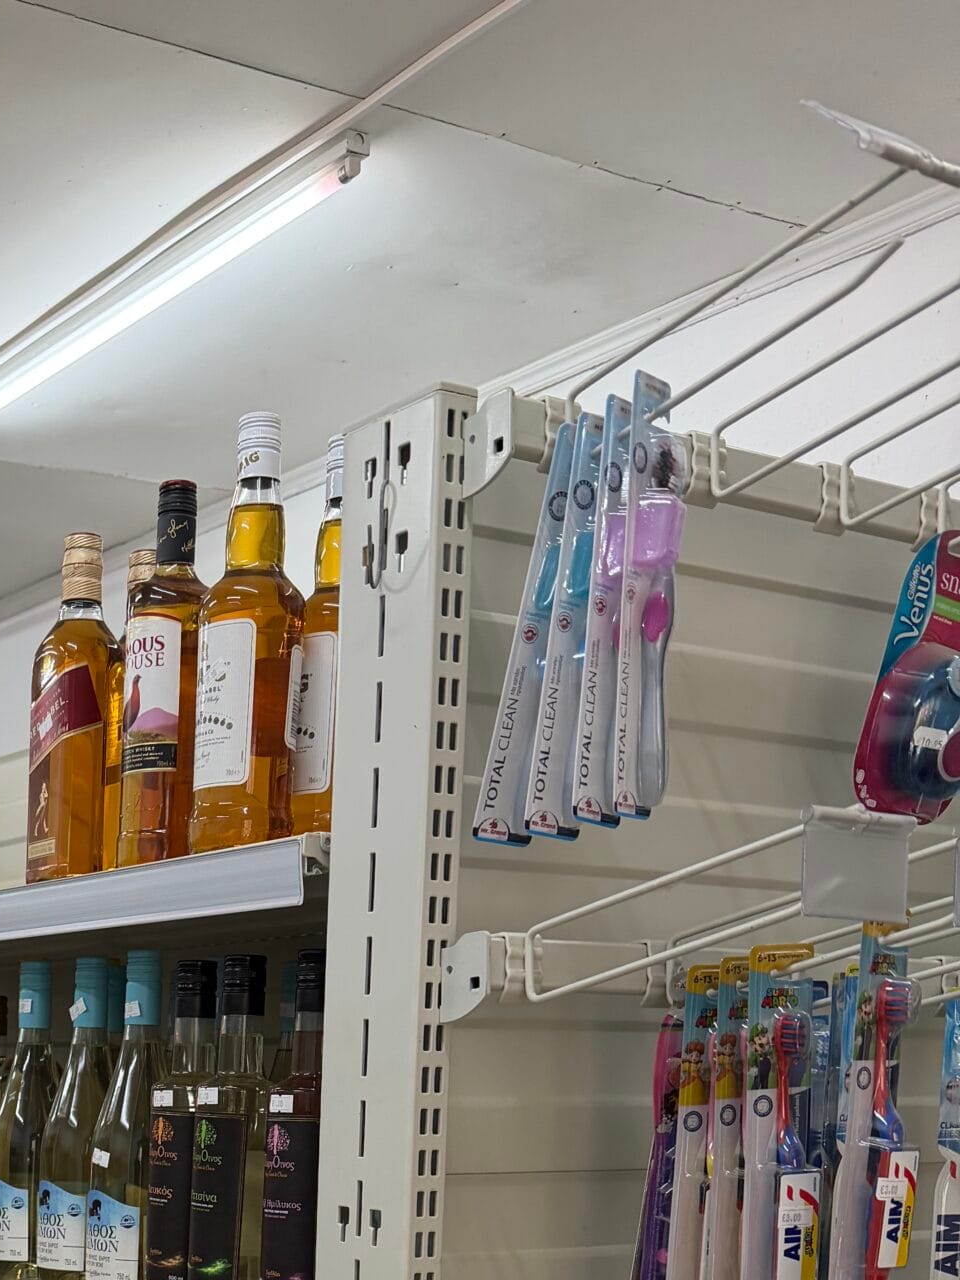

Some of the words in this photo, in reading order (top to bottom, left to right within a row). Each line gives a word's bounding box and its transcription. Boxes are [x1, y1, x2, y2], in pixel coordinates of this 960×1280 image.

[893, 562, 934, 646] Venus
[584, 670, 597, 726] CLEAN
[619, 661, 630, 718] CLEAN
[483, 755, 506, 811] TOTAL
[498, 697, 519, 751] CLEAN
[533, 746, 551, 803] TOTAL
[543, 687, 559, 741] CLEAN
[579, 731, 592, 789] TOTAL
[618, 726, 627, 784] TOTAL
[886, 1198, 904, 1244] AIM
[934, 1213, 960, 1278] AIM
